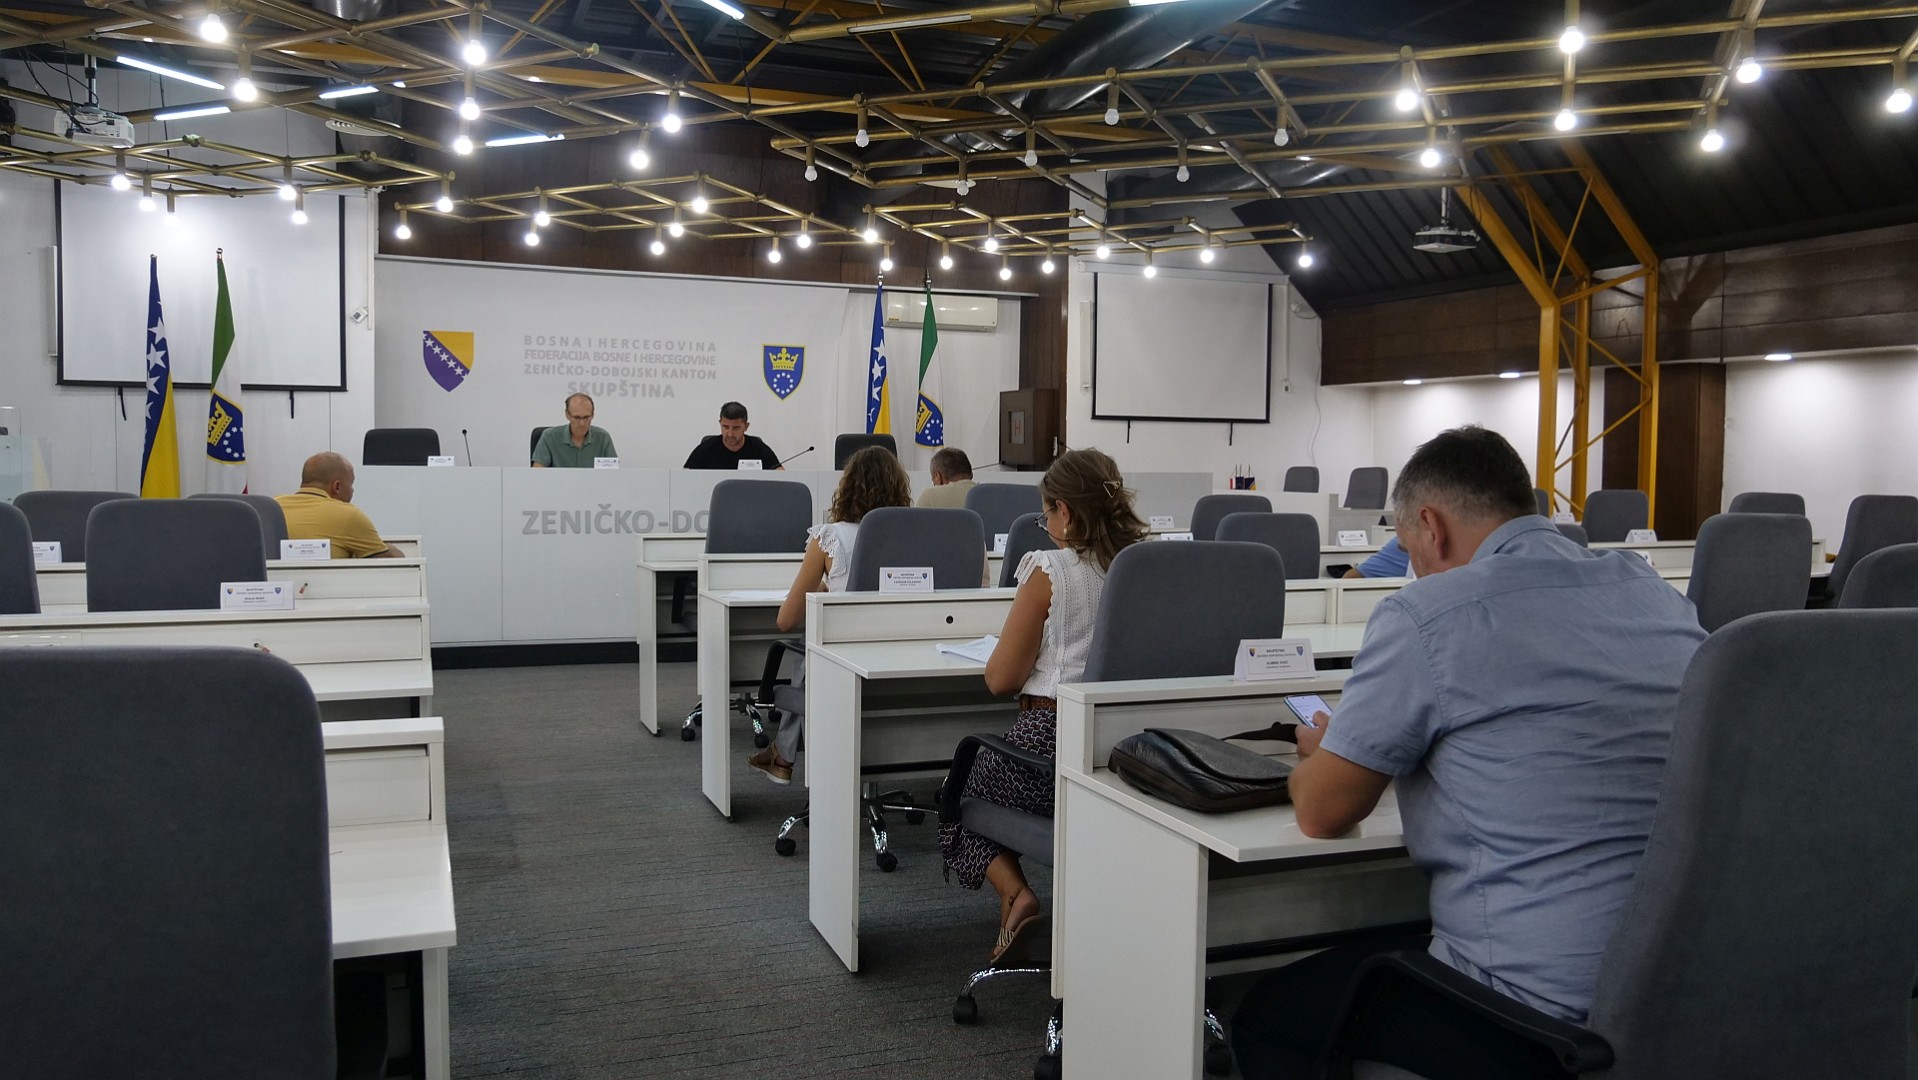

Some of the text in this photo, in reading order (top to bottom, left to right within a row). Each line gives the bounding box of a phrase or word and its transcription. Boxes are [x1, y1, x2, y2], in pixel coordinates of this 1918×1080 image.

[524, 335, 582, 347] BOSNA
[598, 337, 716, 352] HERCEGOVINA
[524, 349, 590, 361] FEDERACIJA
[593, 352, 631, 363] BOSNE
[640, 353, 716, 366] HERCEGOVINE
[524, 363, 716, 380] ZENIČKO-DOBOJSKI KANTON
[567, 379, 675, 398] SKUPŠTINA
